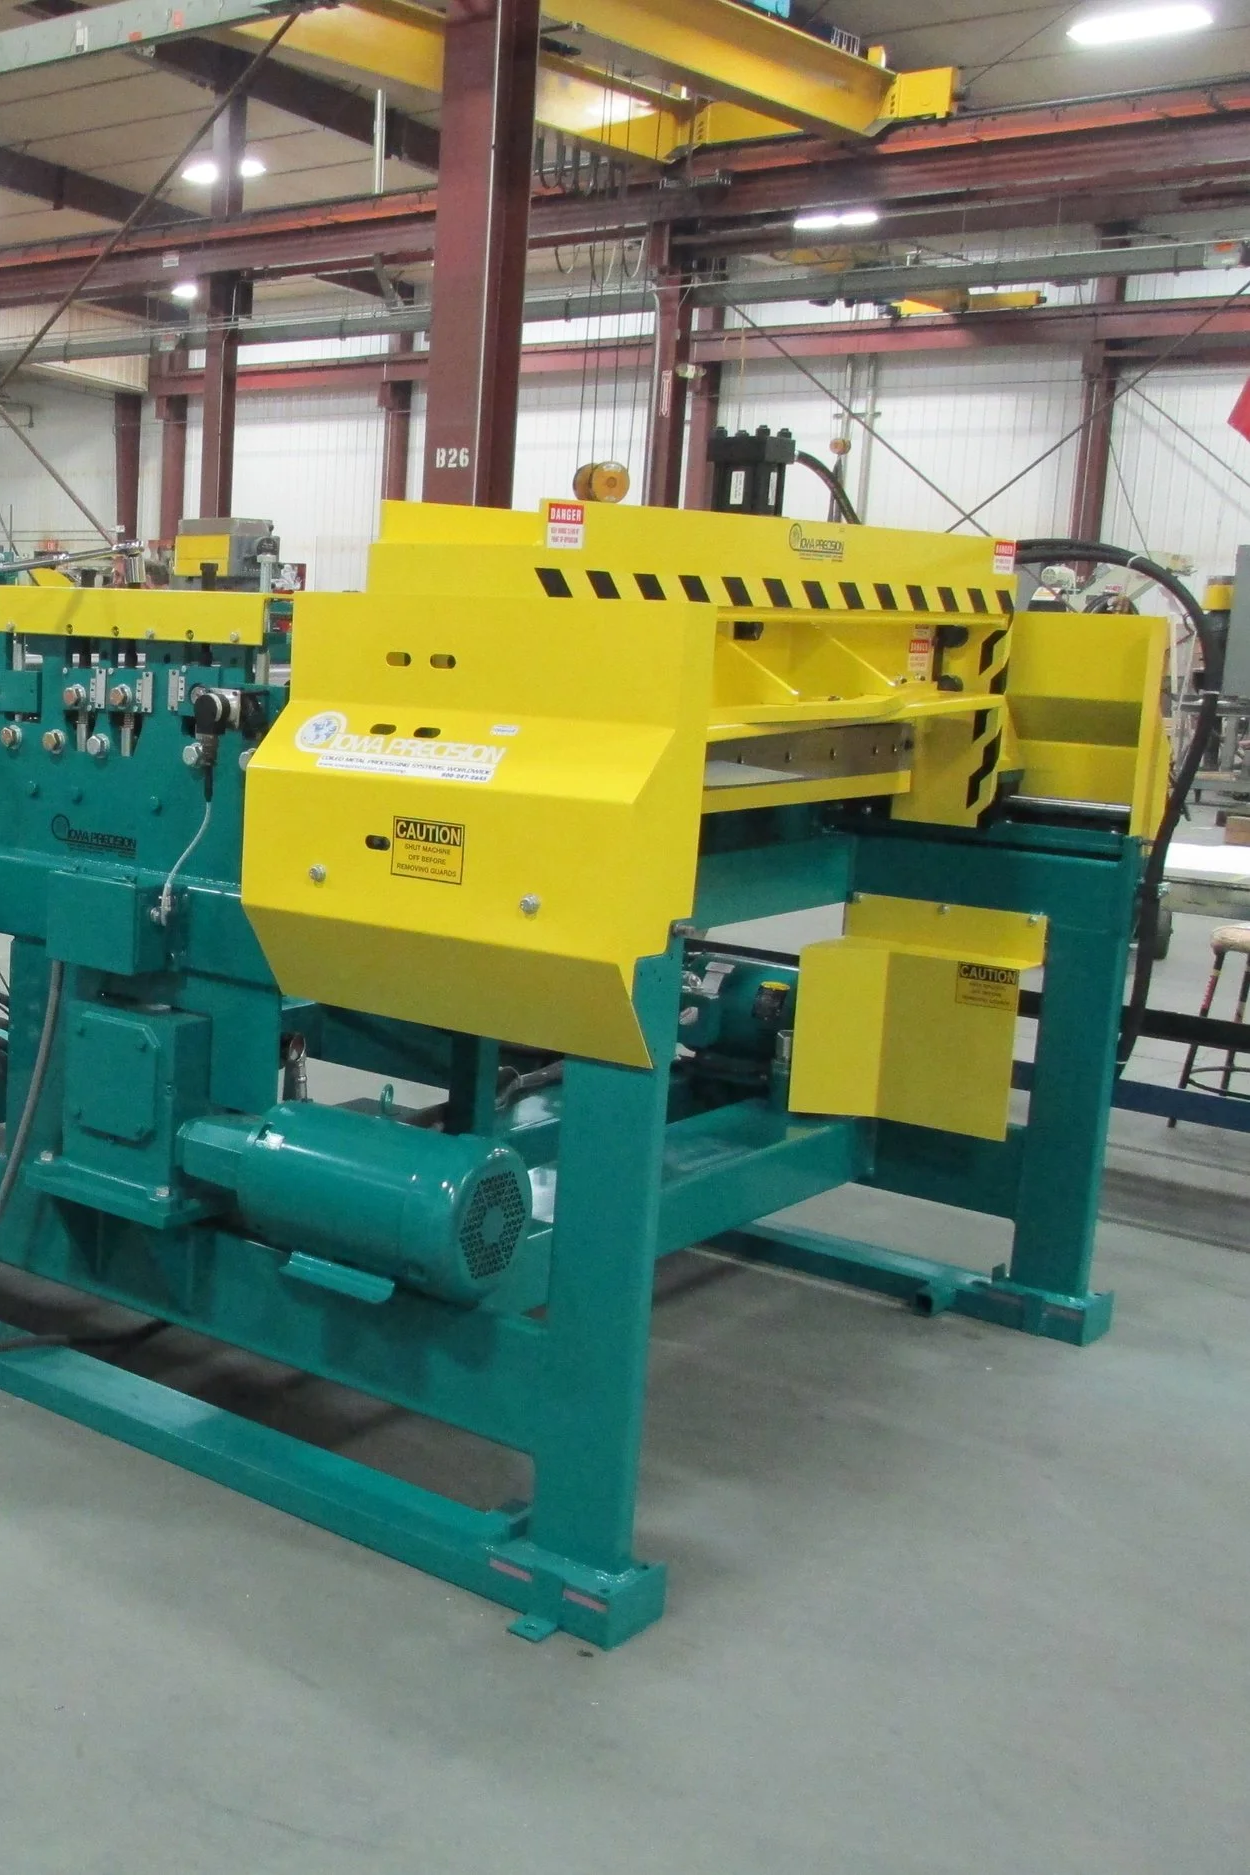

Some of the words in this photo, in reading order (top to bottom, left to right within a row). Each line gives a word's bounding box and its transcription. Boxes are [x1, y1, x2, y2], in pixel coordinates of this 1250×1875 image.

[436, 448, 469, 468] B26
[550, 507, 582, 521] DANGER
[330, 734, 385, 755] IOWA
[386, 738, 506, 766] PRECISION
[397, 821, 461, 845] CAUTION
[405, 843, 421, 851] SHUT
[422, 846, 451, 855] MACHINE
[421, 856, 446, 865] BEFORE
[396, 863, 429, 873] REMOVING
[430, 868, 456, 877] GUARDS
[960, 965, 1016, 985] CAUTION
